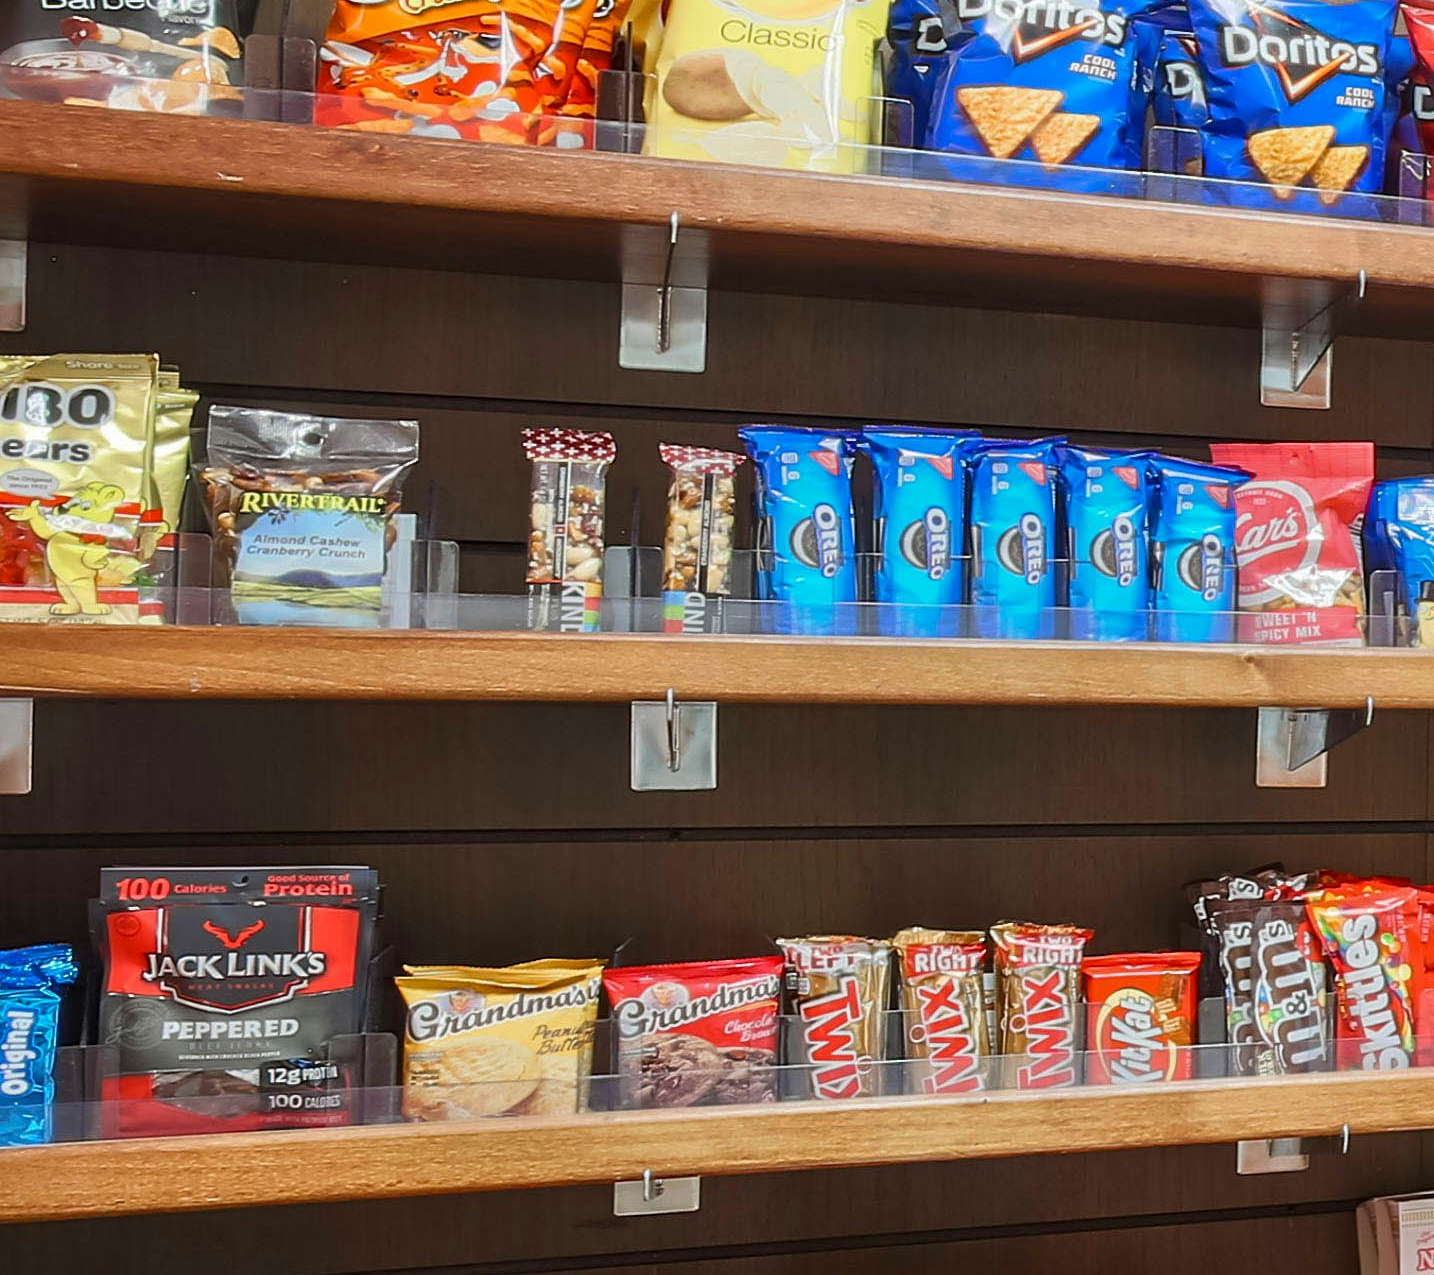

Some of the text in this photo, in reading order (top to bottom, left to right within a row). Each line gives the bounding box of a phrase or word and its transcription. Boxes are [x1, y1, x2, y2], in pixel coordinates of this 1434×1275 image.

[720, 19, 840, 53] Classic
[1221, 23, 1380, 75] Doritos
[1069, 61, 1118, 82] RANCH
[1334, 93, 1376, 110] RANCH
[1343, 85, 1376, 100] COOL
[240, 491, 382, 515] RIVERTRAIL
[246, 545, 367, 560] Cranberry Crunch
[254, 534, 362, 548] Almond Cashew
[813, 503, 844, 579] OREO
[925, 505, 953, 581] OREO
[1020, 513, 1046, 585] OREO
[1112, 514, 1138, 587] OREO
[1202, 534, 1224, 602] OREO
[1255, 629, 1322, 642] SPICY MIX
[116, 877, 228, 900] 100 Calories
[263, 881, 354, 897] Protein
[267, 872, 351, 883] Good Source of
[914, 952, 980, 972] RIGHT
[613, 975, 782, 1041] Grandma's
[1342, 913, 1410, 1071] Skittles
[160, 1018, 300, 1040] PEPPERED
[405, 983, 587, 1044] Grandma's
[1017, 970, 1076, 1091] TWIX
[1, 1011, 35, 1095] Original
[1111, 995, 1166, 1084] KitKat
